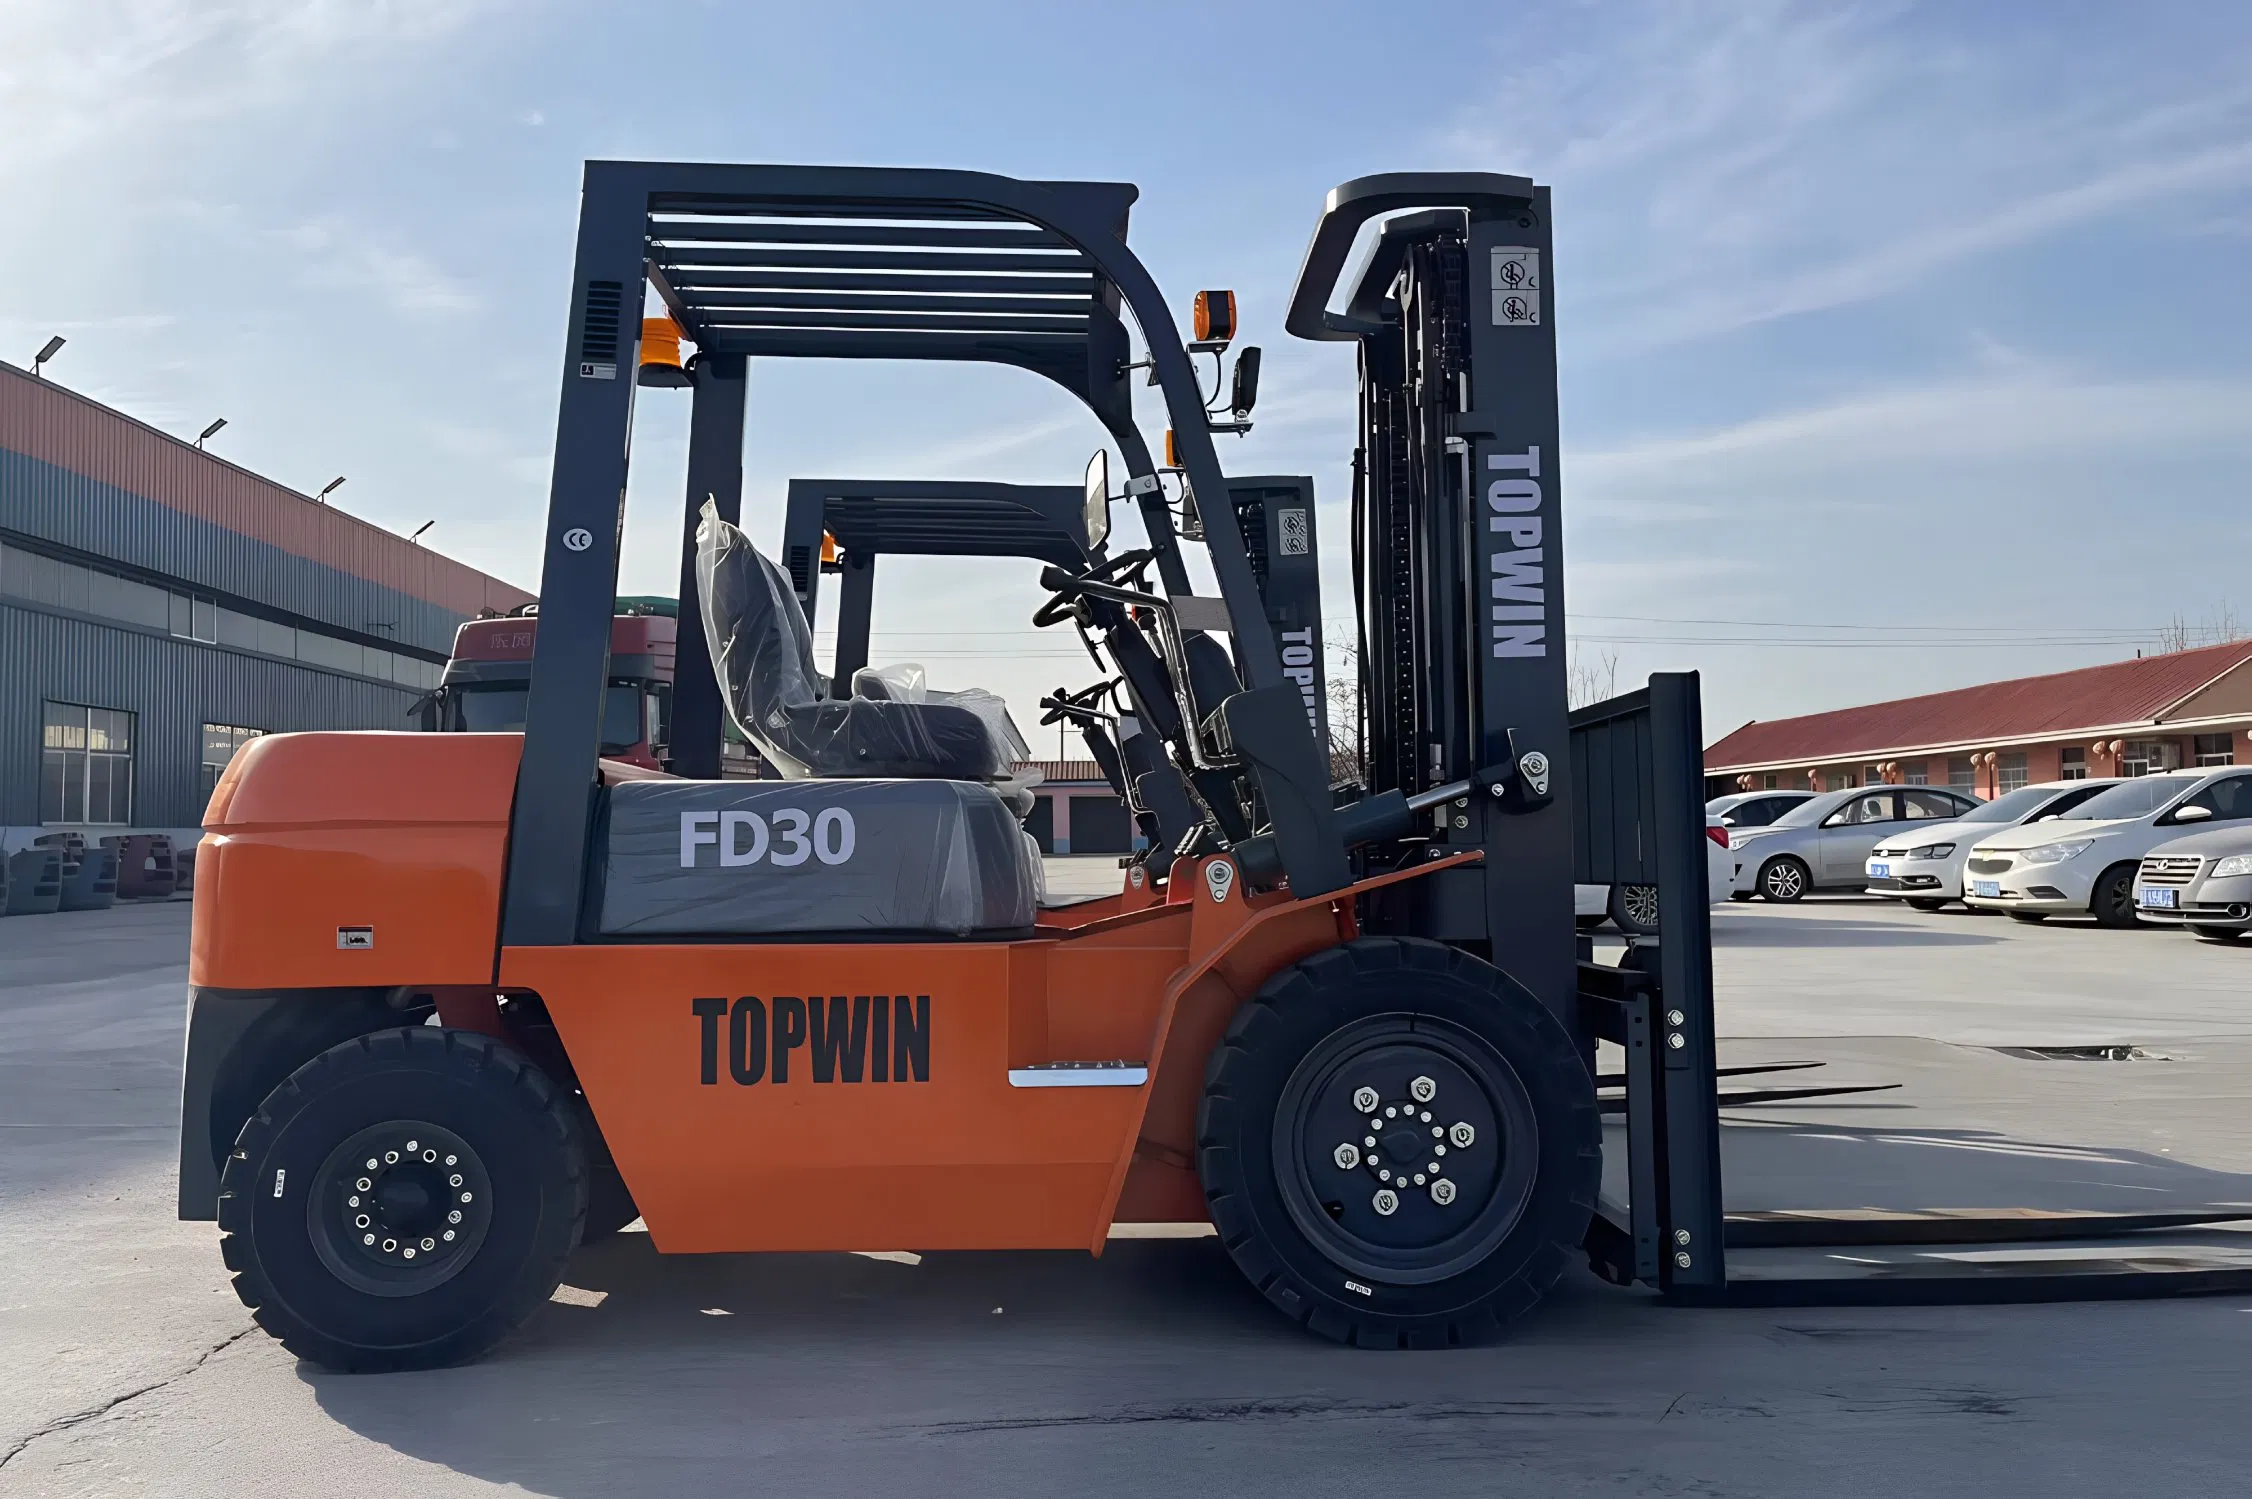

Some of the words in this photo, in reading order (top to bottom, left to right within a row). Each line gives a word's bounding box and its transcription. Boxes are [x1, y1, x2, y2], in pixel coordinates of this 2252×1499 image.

[1487, 445, 1546, 658] TOPWIN
[680, 806, 856, 868] FD30
[692, 995, 931, 1086] TOPWIN
